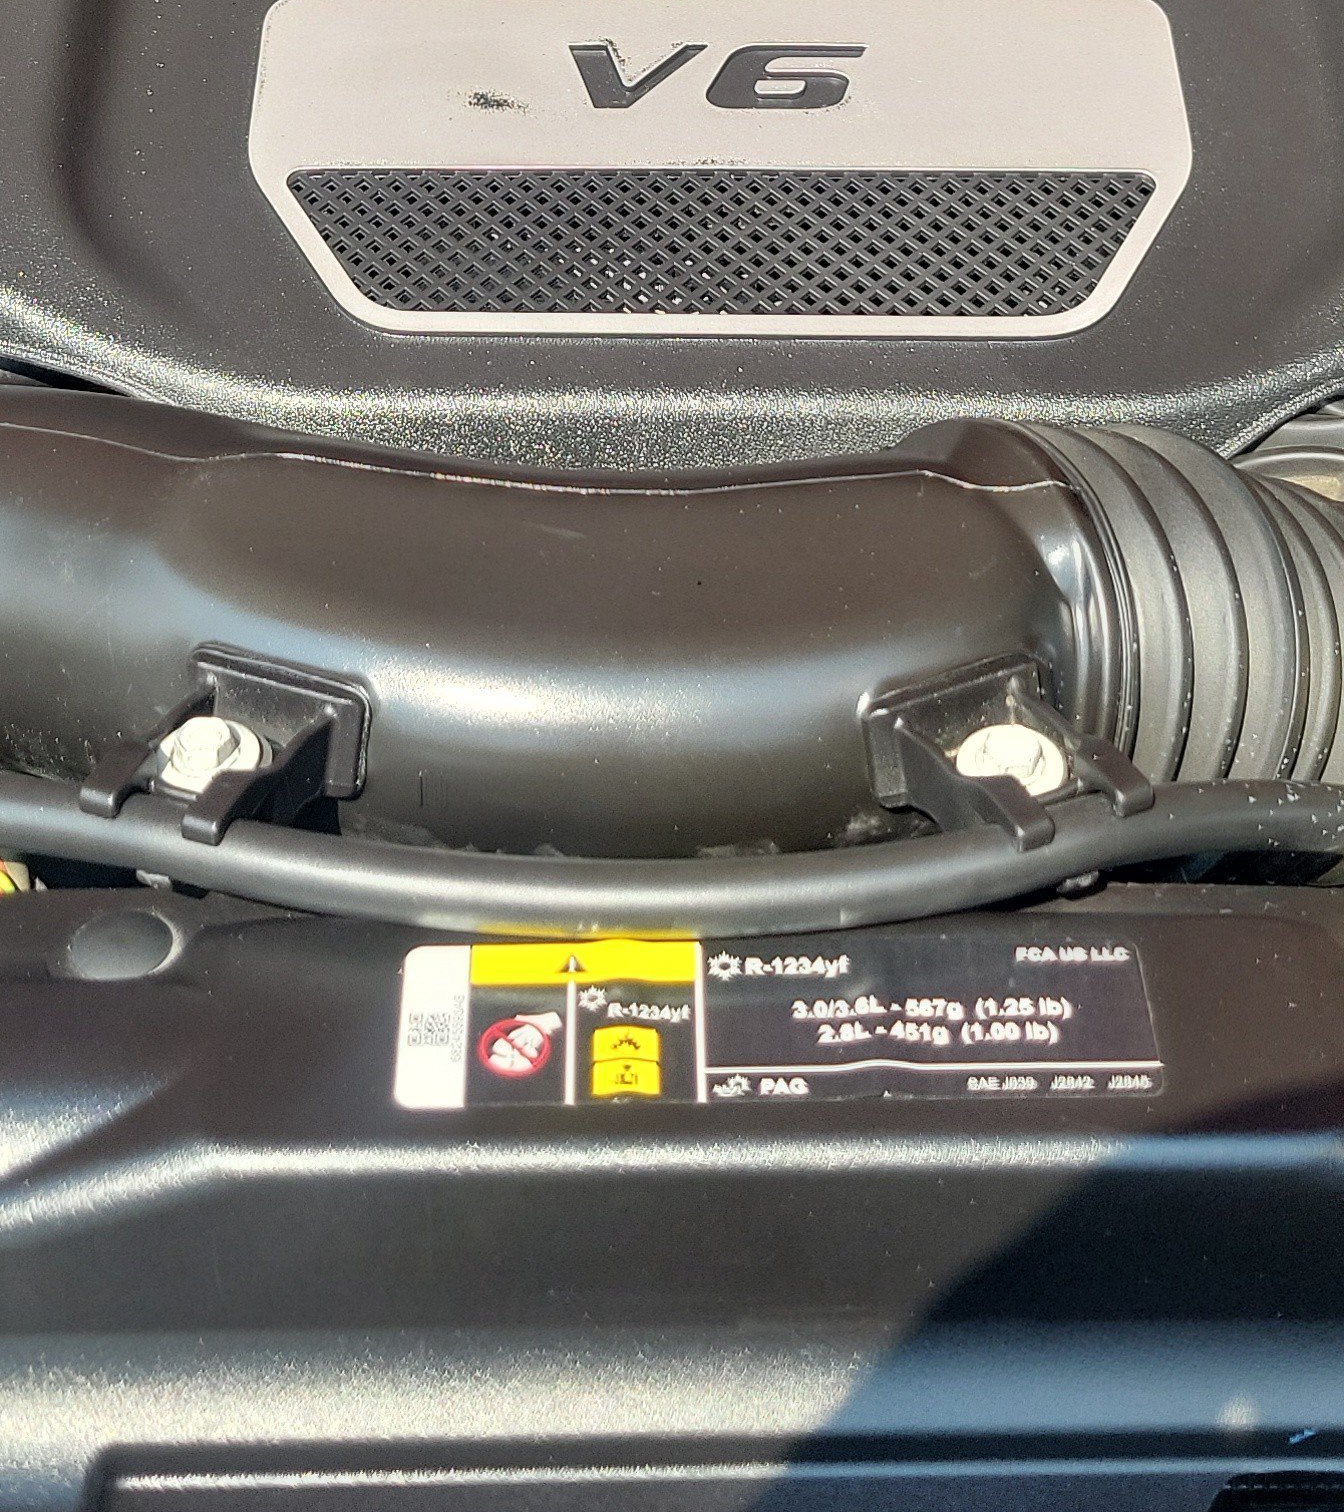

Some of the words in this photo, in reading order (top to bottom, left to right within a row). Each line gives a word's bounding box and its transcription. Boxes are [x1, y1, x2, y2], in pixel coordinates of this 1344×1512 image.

[567, 41, 869, 110] V6
[743, 952, 852, 979] R-1234yf
[1014, 945, 1057, 963] FCA
[1058, 945, 1088, 963] US
[1090, 944, 1131, 963] LLC
[606, 1000, 692, 1024] R-1234yf
[790, 994, 886, 1020] 3.0/3.6L
[904, 997, 965, 1021] 567g
[974, 996, 1035, 1021] (1.25
[1038, 995, 1073, 1020] lb)
[816, 1021, 872, 1045] 2.8L
[888, 1020, 952, 1047] 451g
[959, 1020, 1021, 1046] (1.00
[1025, 1020, 1060, 1045] lb)
[758, 1077, 811, 1097] PAG
